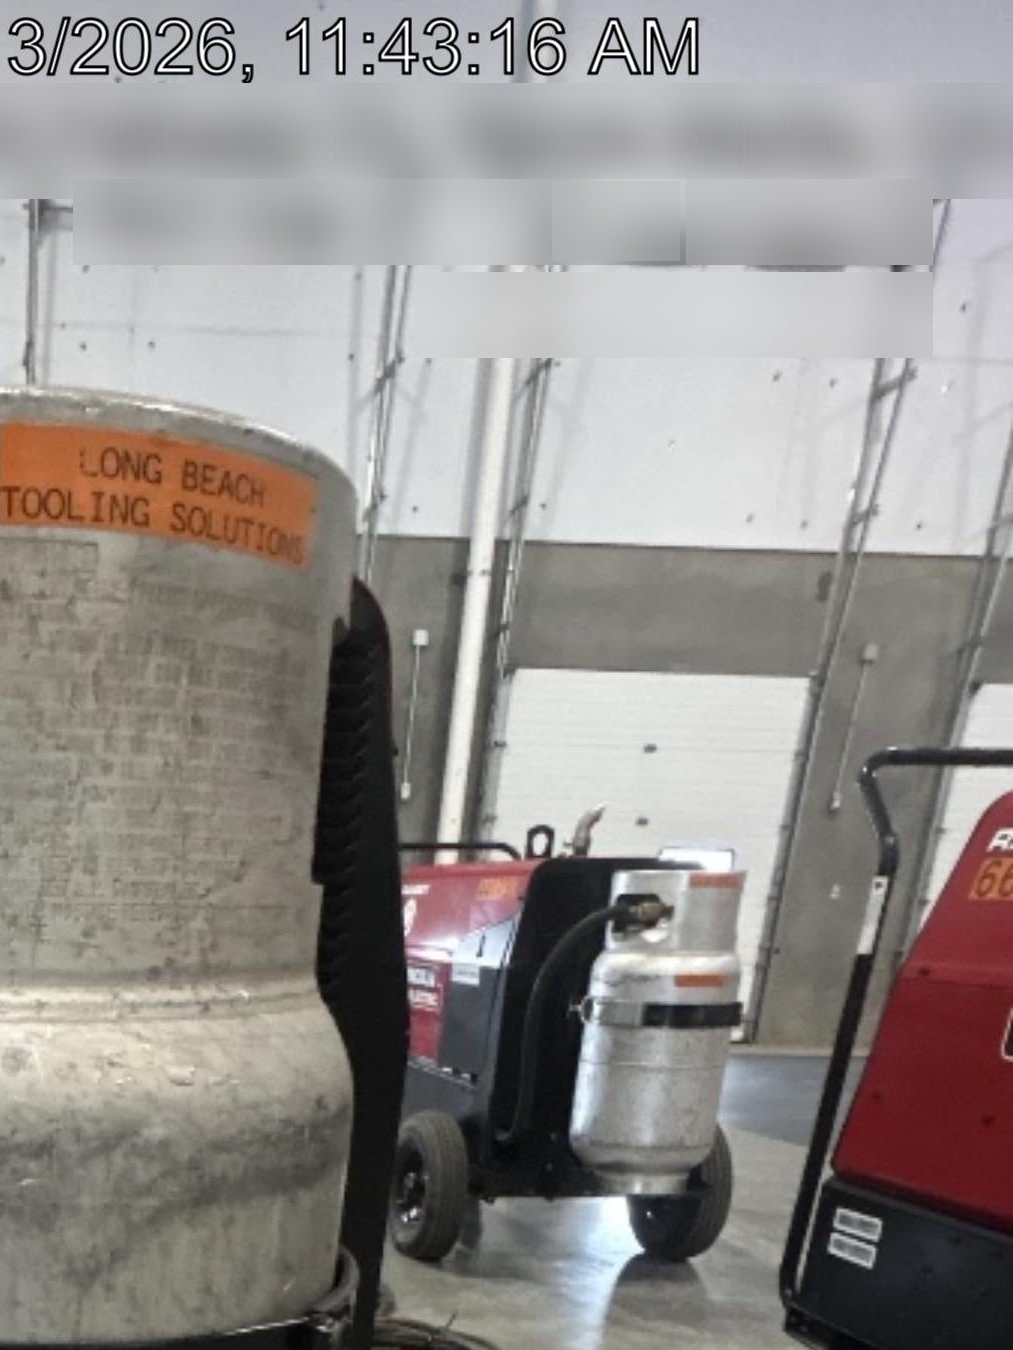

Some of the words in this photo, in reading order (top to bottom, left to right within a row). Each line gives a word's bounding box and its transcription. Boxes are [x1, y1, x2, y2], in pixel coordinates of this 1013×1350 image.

[79, 446, 163, 486] LONG
[181, 460, 265, 507] BEACH
[0, 485, 151, 529] TOOLING
[170, 501, 304, 566] SOLUTIONS
